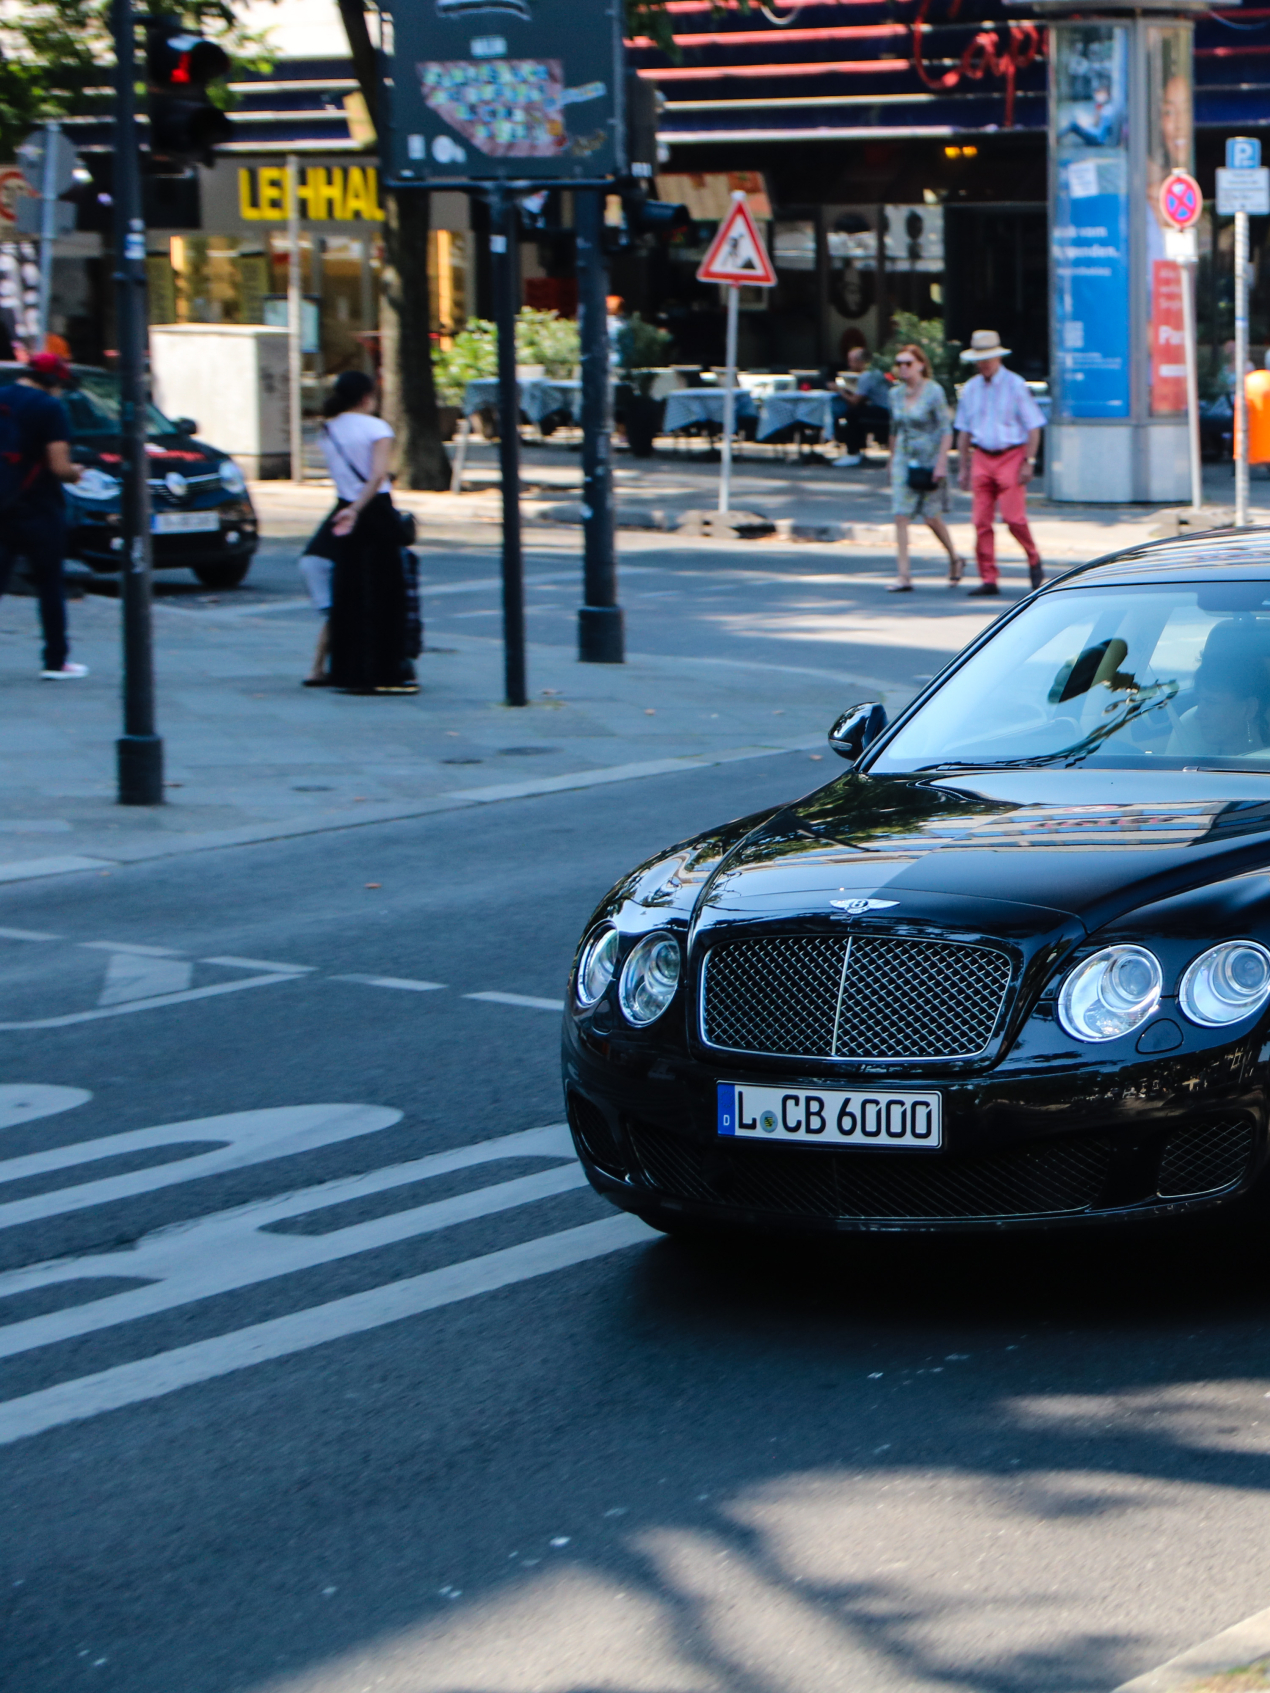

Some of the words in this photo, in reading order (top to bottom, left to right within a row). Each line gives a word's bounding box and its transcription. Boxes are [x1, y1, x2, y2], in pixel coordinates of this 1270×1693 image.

[1234, 142, 1253, 167] P
[723, 1114, 730, 1126] D
[738, 1090, 757, 1130] L
[782, 1094, 827, 1135] CB
[836, 1097, 933, 1139] 6000
